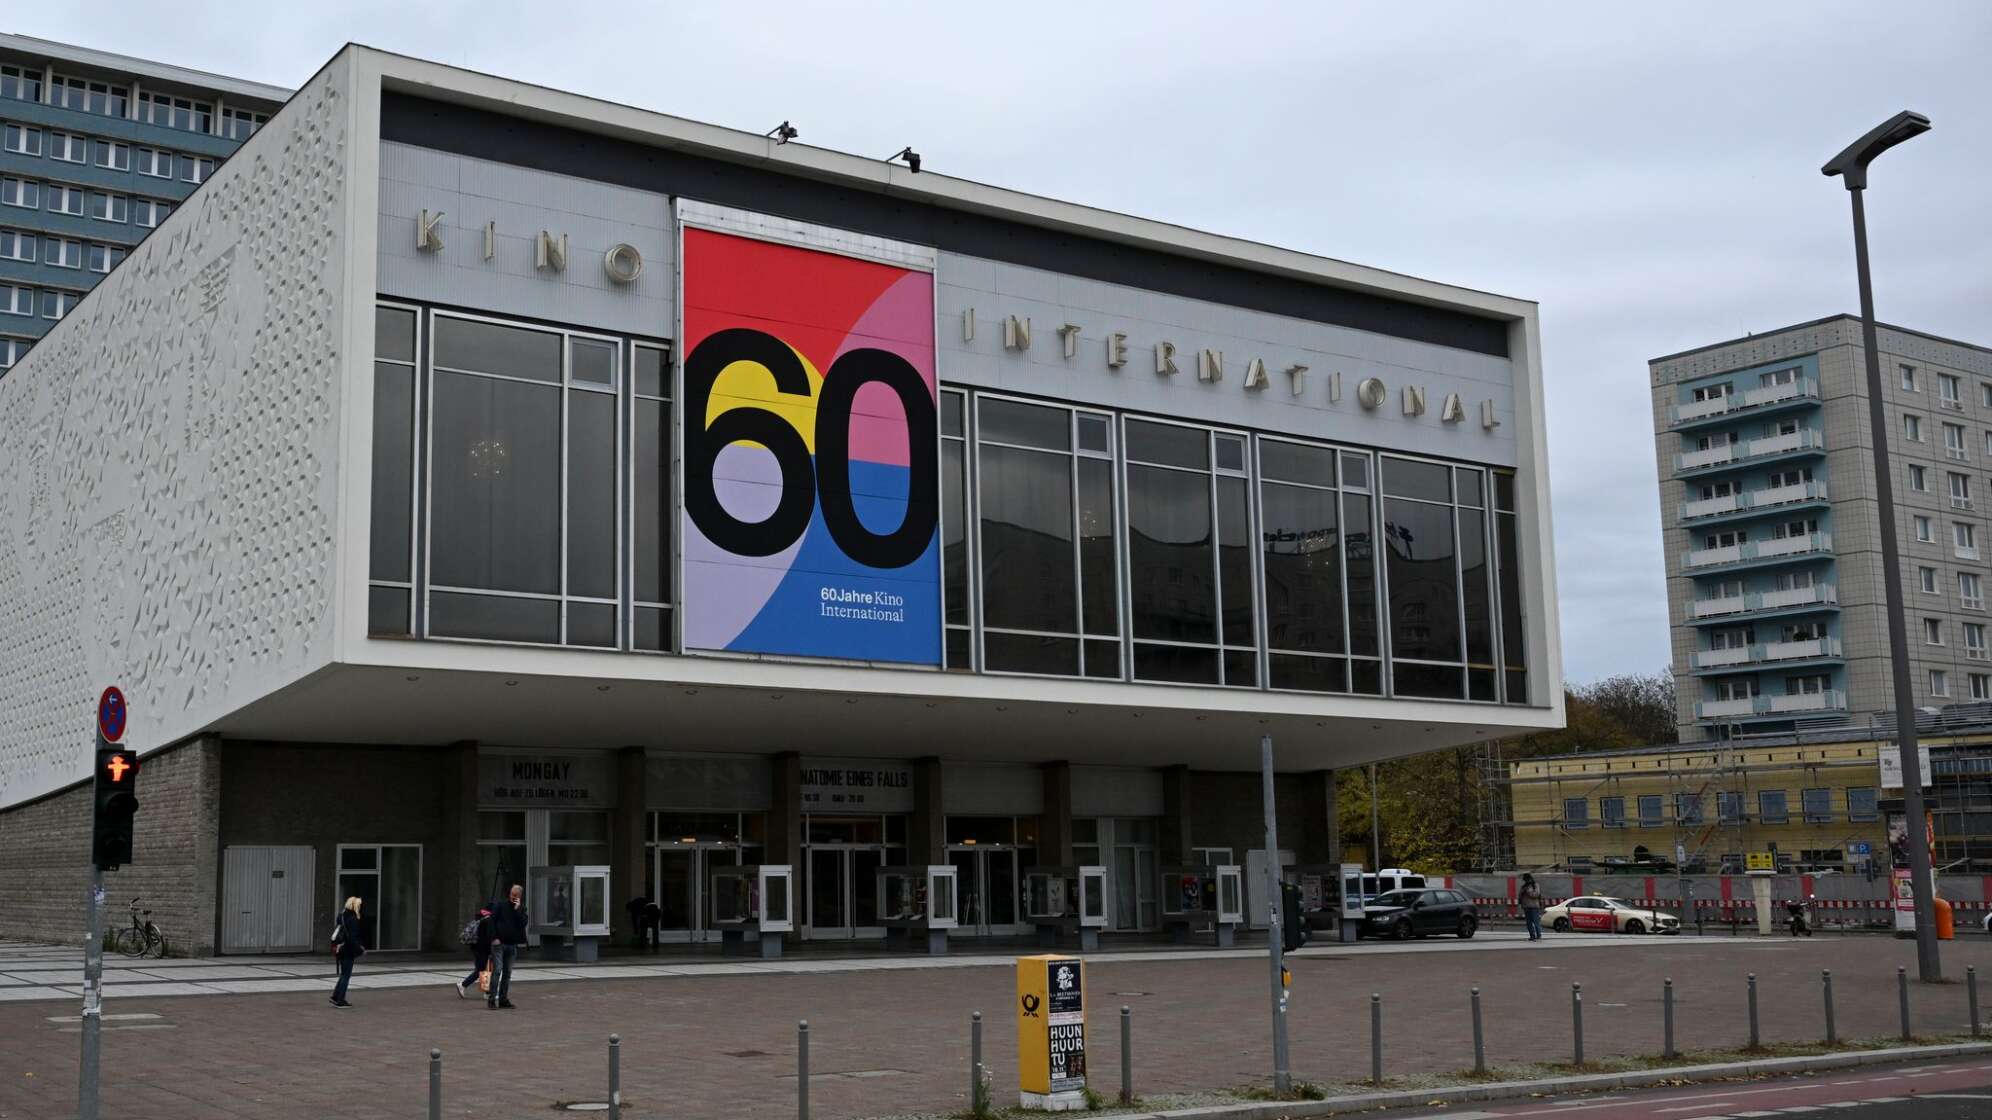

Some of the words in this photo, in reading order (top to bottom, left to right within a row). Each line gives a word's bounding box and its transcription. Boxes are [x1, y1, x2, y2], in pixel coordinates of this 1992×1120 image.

[416, 208, 643, 284] KINO
[961, 307, 1501, 431] INTERNATIONAL
[684, 328, 939, 569] 60
[874, 591, 904, 607] Kino
[821, 602, 904, 622] International
[512, 762, 571, 780] MONGAY
[878, 771, 909, 788] FALLS
[1050, 1026, 1082, 1039] HUUN
[1051, 1038, 1084, 1053] HUUR
[1051, 1053, 1065, 1066] TU
